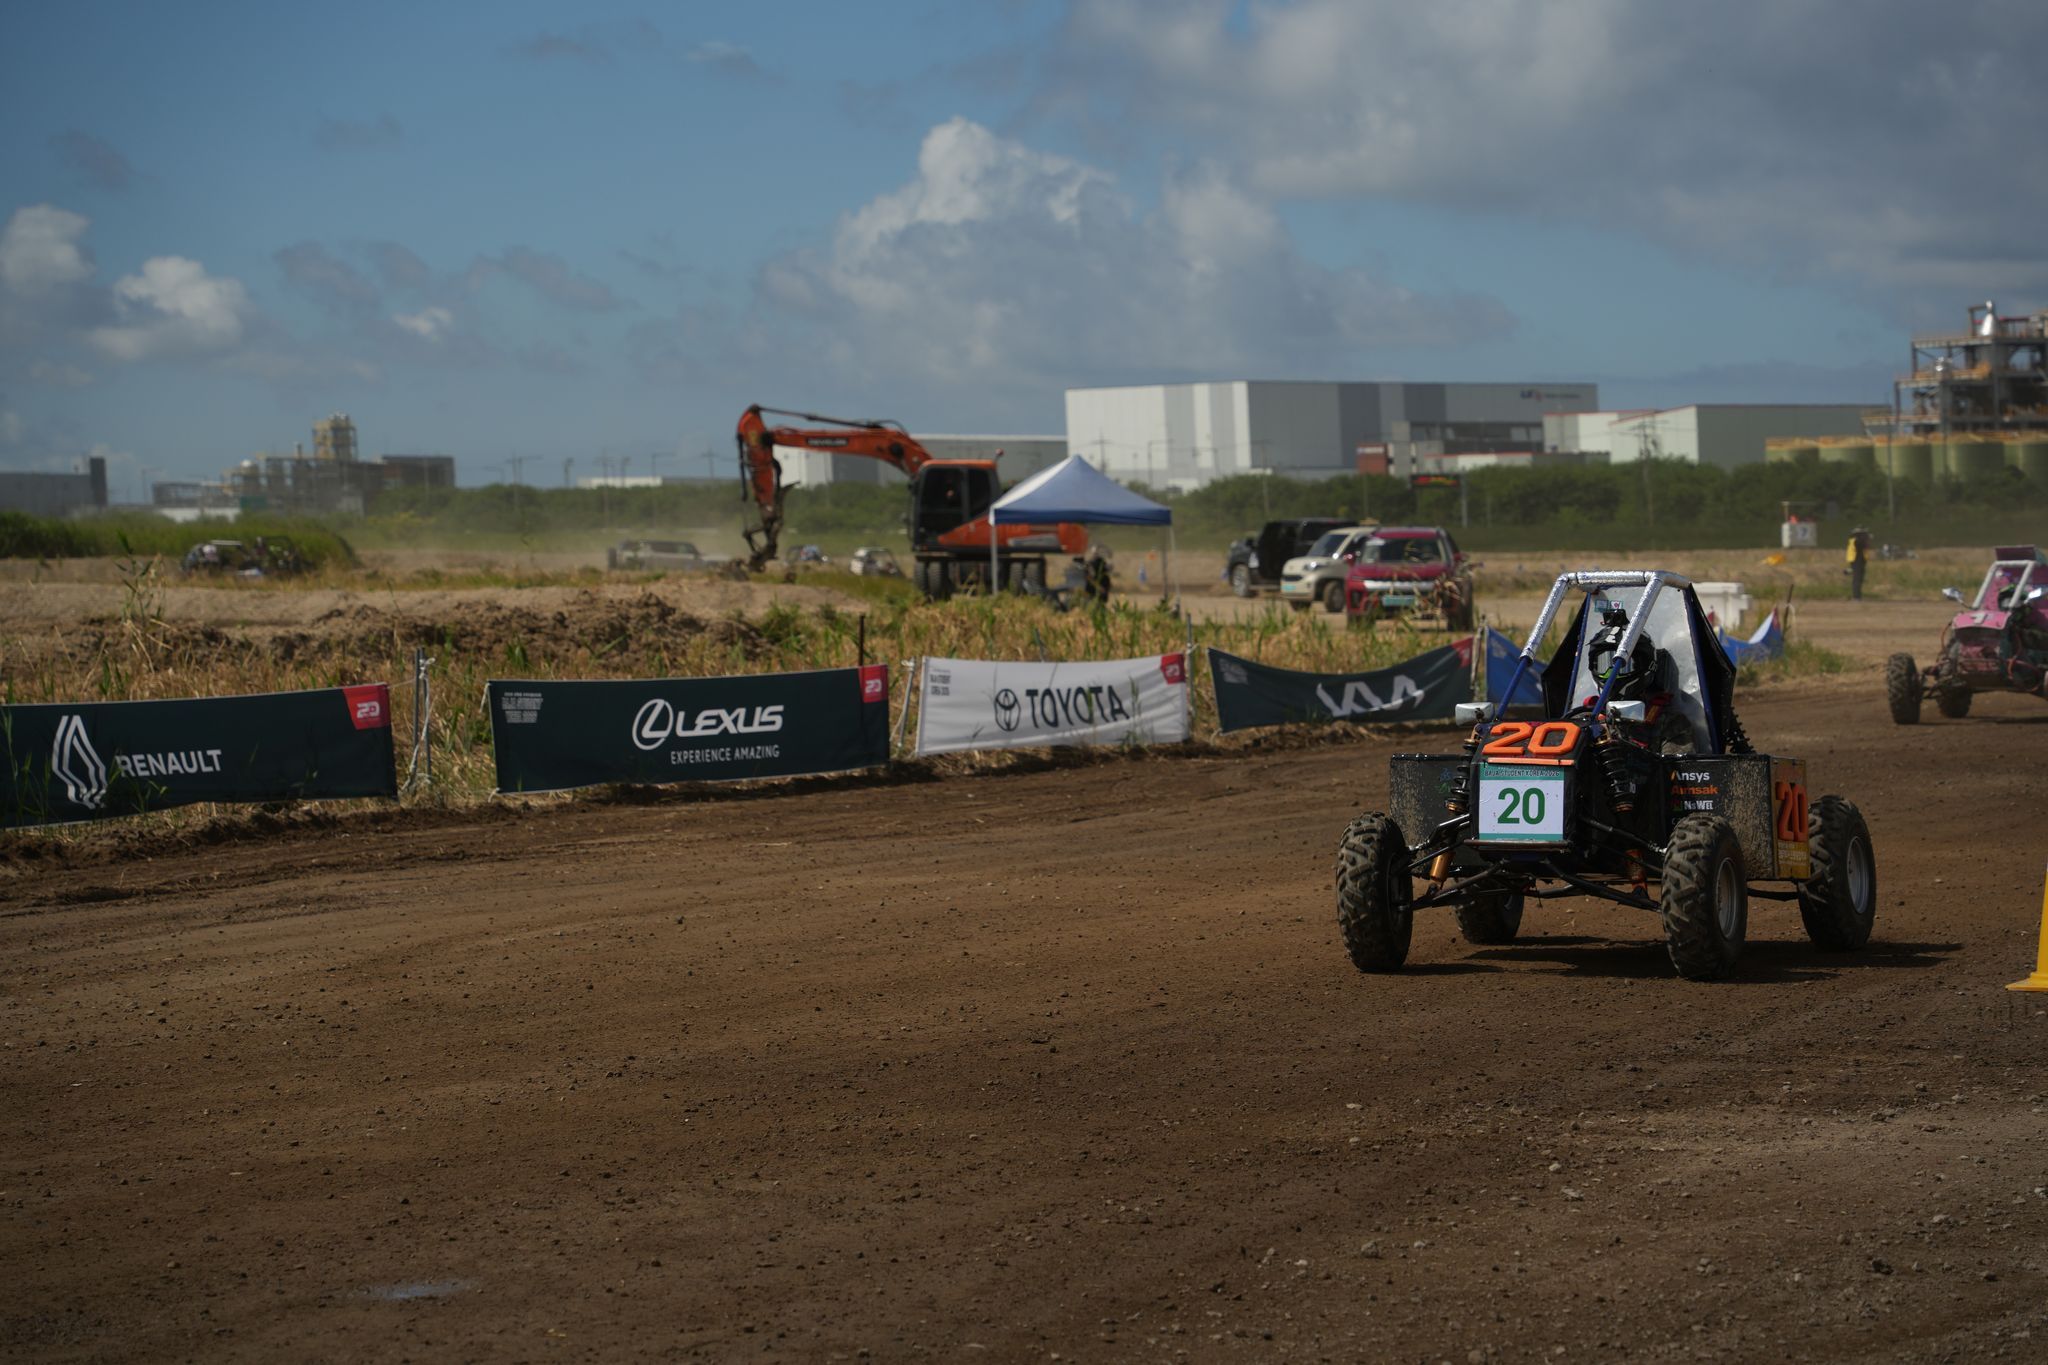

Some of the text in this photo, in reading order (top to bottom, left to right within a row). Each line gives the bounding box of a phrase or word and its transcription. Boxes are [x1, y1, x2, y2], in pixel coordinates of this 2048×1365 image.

[675, 704, 785, 737] LEXUS
[1026, 685, 1130, 729] TOYOTA
[670, 744, 780, 765] EXPERIENCE AMAZING
[1482, 721, 1581, 755] 20
[114, 748, 222, 778] RENAULT
[1484, 769, 1501, 777] BAJA
[1501, 769, 1525, 777] STUDENT
[1525, 769, 1544, 777] KOREA
[1668, 769, 1711, 783] Ansys
[1497, 787, 1546, 824] 20
[1775, 782, 1808, 842] 20
